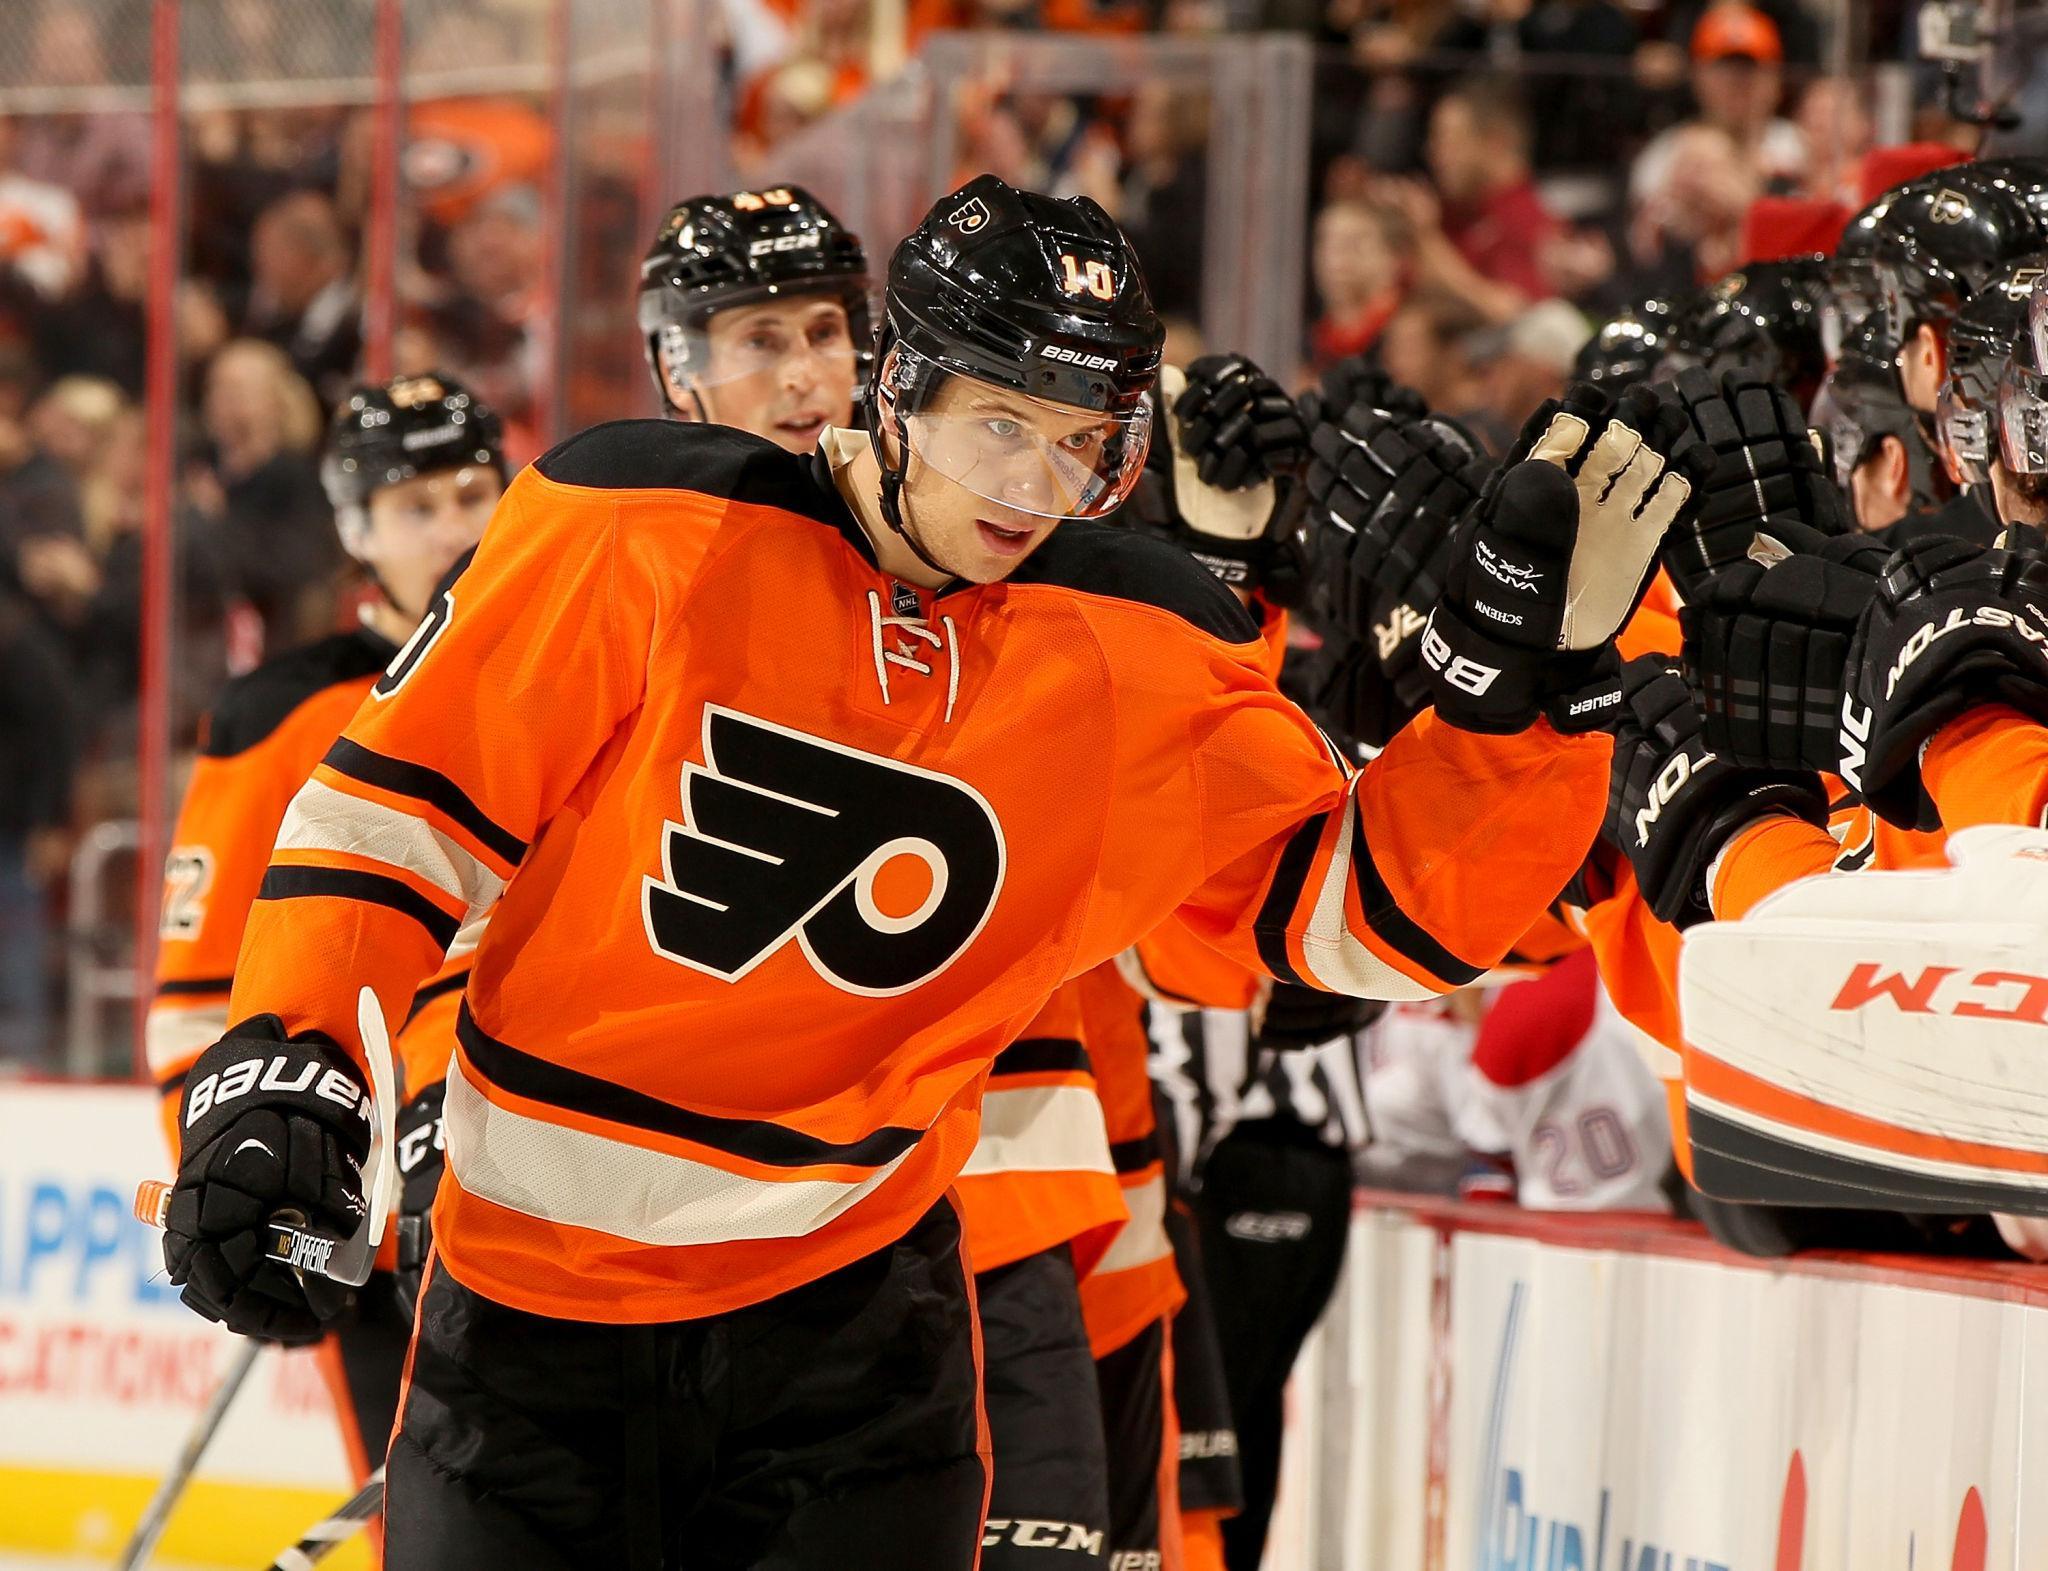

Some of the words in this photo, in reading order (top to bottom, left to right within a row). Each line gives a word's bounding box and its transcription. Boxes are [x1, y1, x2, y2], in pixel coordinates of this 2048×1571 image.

[750, 232, 821, 257] CCM
[1060, 253, 1115, 301] 10
[898, 596, 917, 609] NHL
[1474, 599, 1524, 626] SCHENN
[1533, 1106, 1636, 1197] 20
